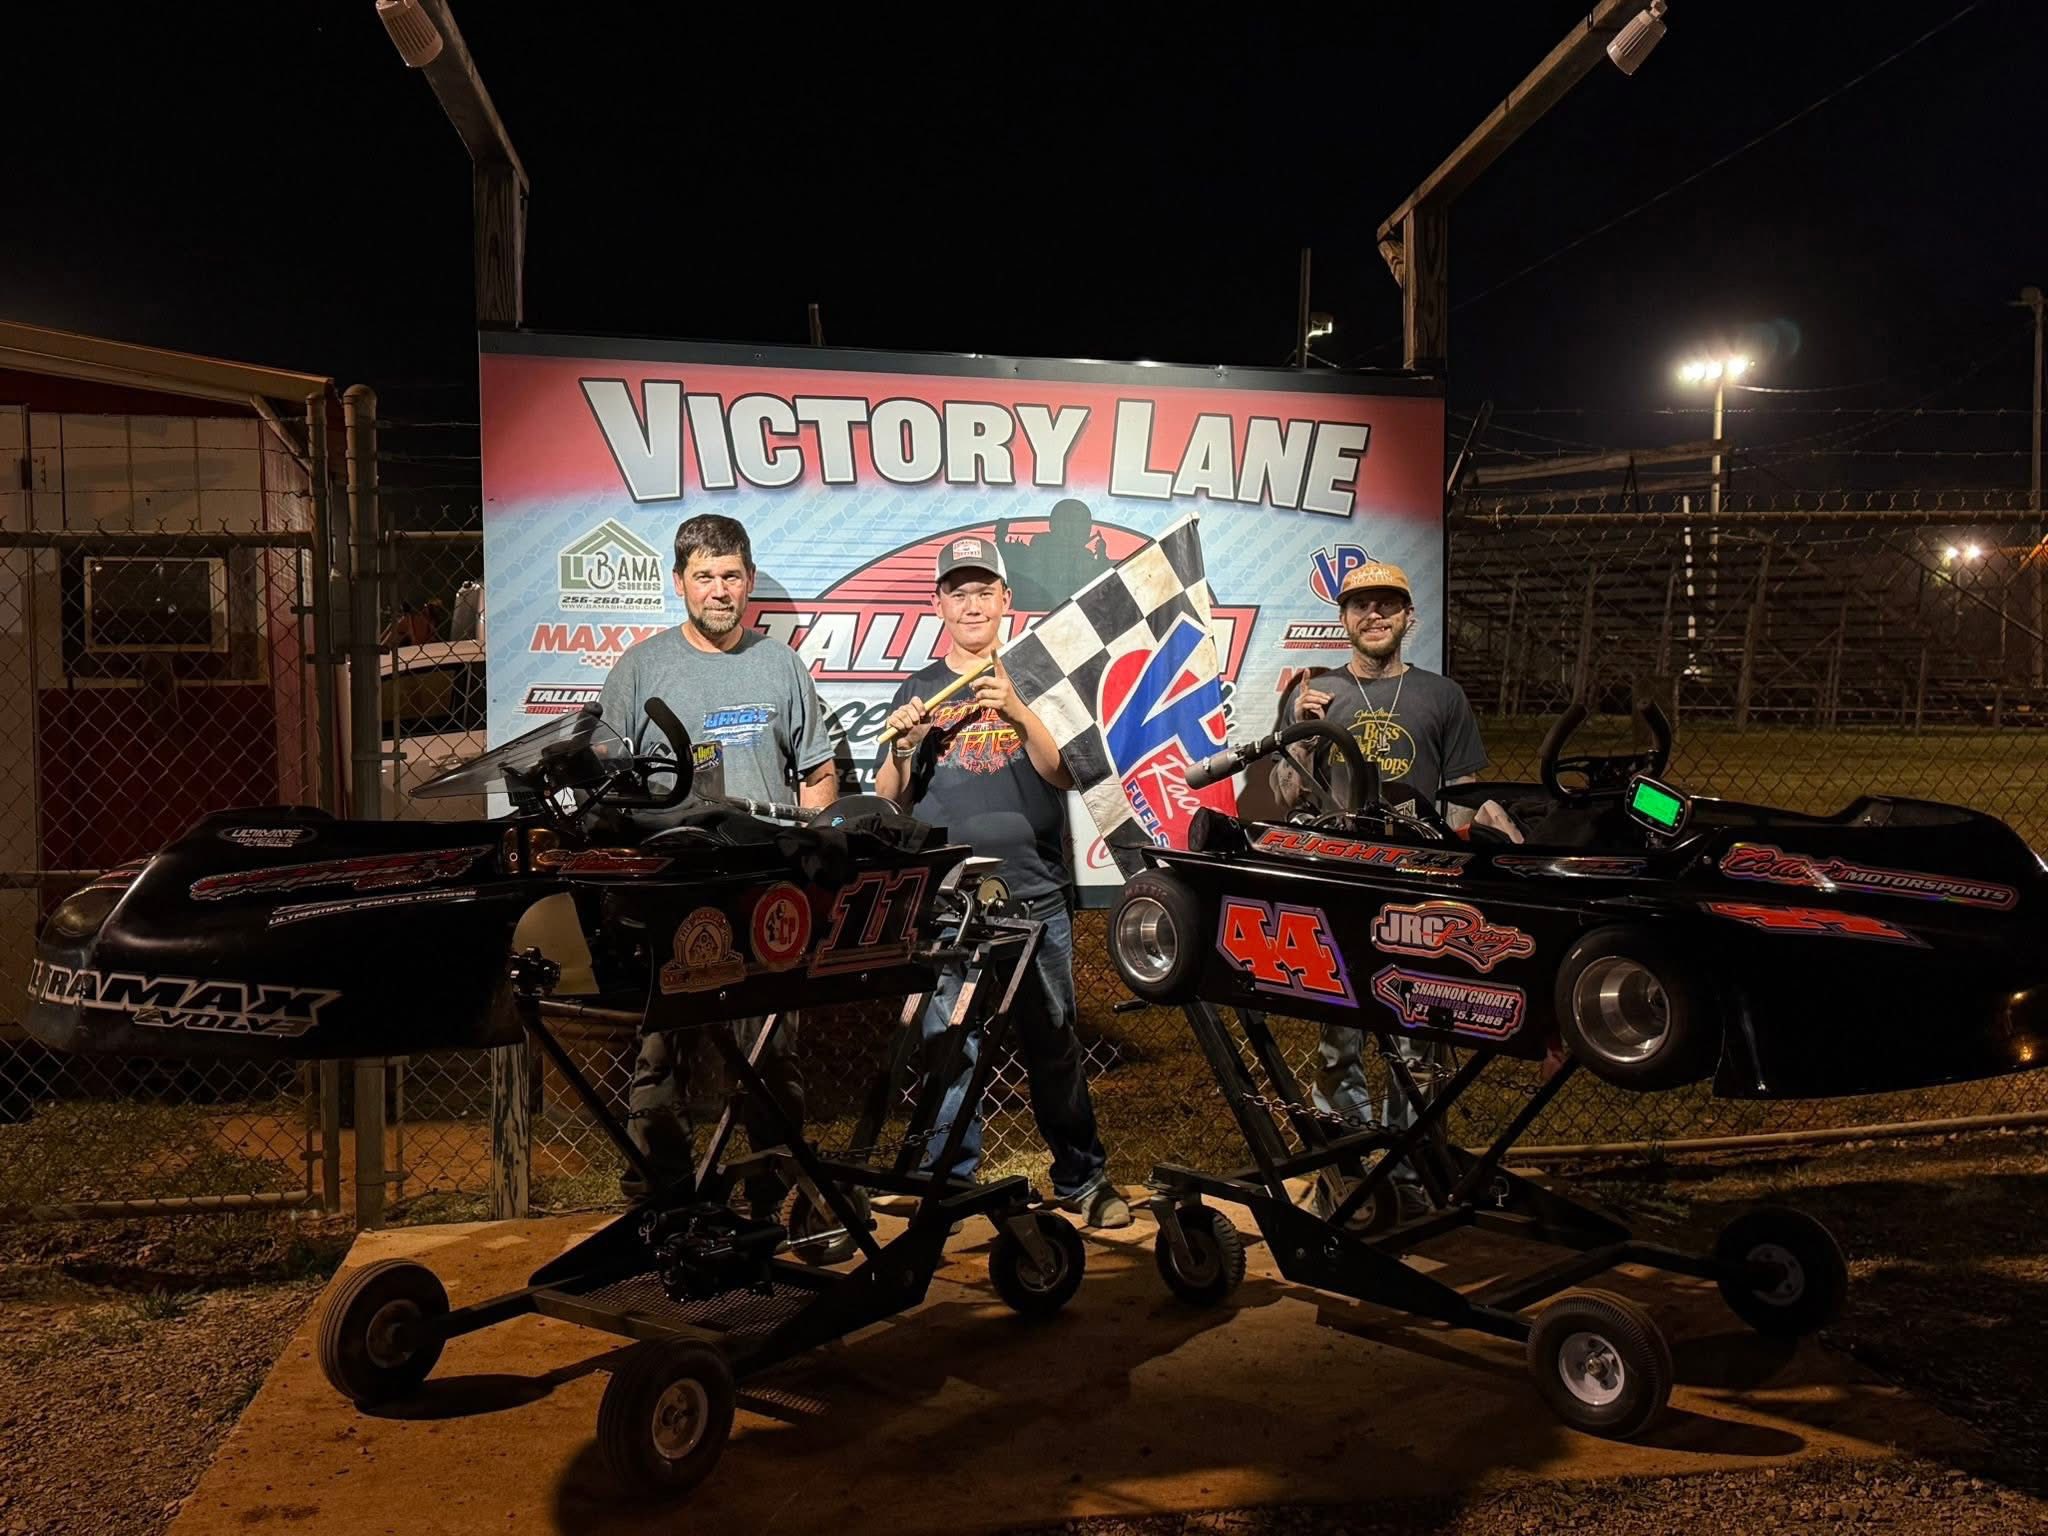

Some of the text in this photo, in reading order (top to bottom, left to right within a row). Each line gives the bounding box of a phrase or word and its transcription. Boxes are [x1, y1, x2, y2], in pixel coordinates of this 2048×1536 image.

[580, 377, 1372, 517] VICTORY LANE
[588, 551, 661, 590] BAMA
[617, 582, 661, 591] SHEDS
[1314, 547, 1367, 600] VP
[531, 624, 669, 651] MAXX
[531, 690, 602, 702] TALLAD
[1125, 779, 1170, 848] FUELS
[232, 828, 303, 837] ULTIMATE
[1261, 830, 1417, 864] FLIGHT
[1847, 870, 2009, 901] MOTORSPORTS
[820, 868, 928, 955] 11
[1380, 911, 1444, 948] JRC
[1220, 900, 1348, 998] 44
[1411, 981, 1515, 1010] SHANNON CHOATE
